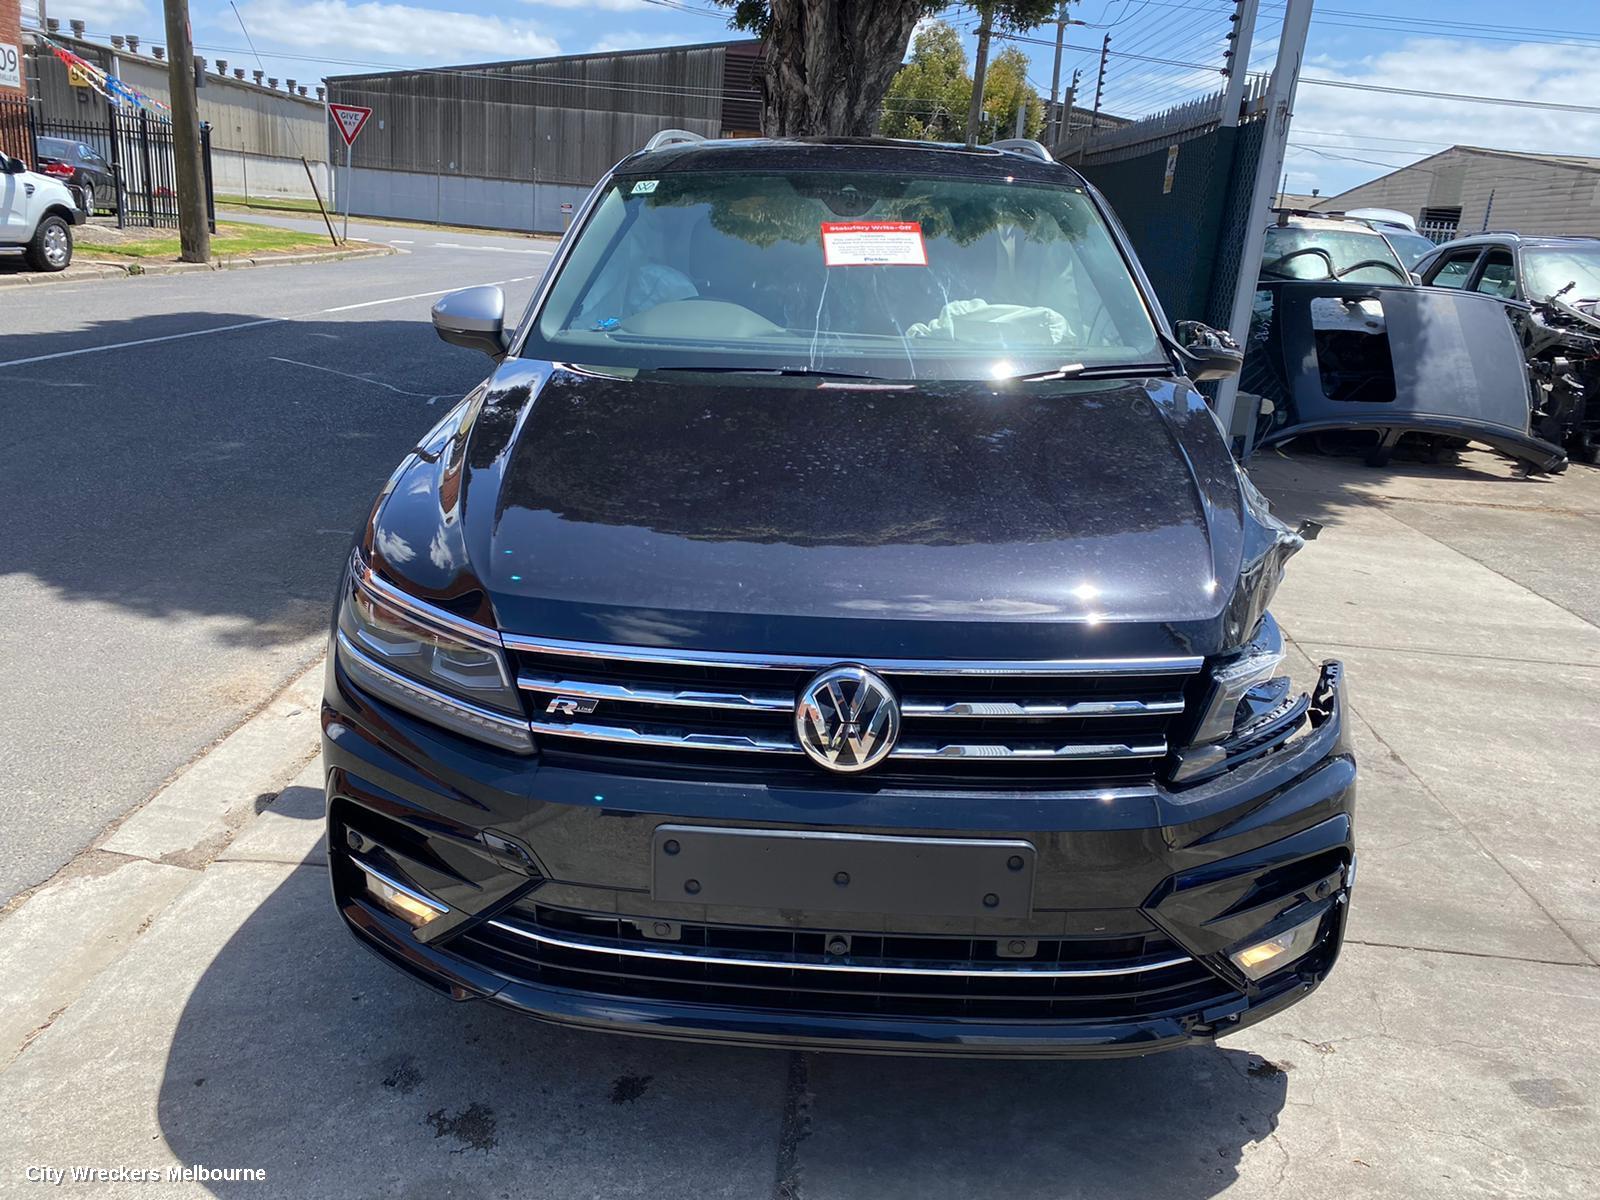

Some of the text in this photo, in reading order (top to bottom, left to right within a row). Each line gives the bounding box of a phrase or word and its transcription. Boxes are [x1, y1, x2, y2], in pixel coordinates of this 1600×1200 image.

[340, 112, 360, 121] GIVE
[546, 699, 578, 715] R
[798, 669, 898, 769] VW
